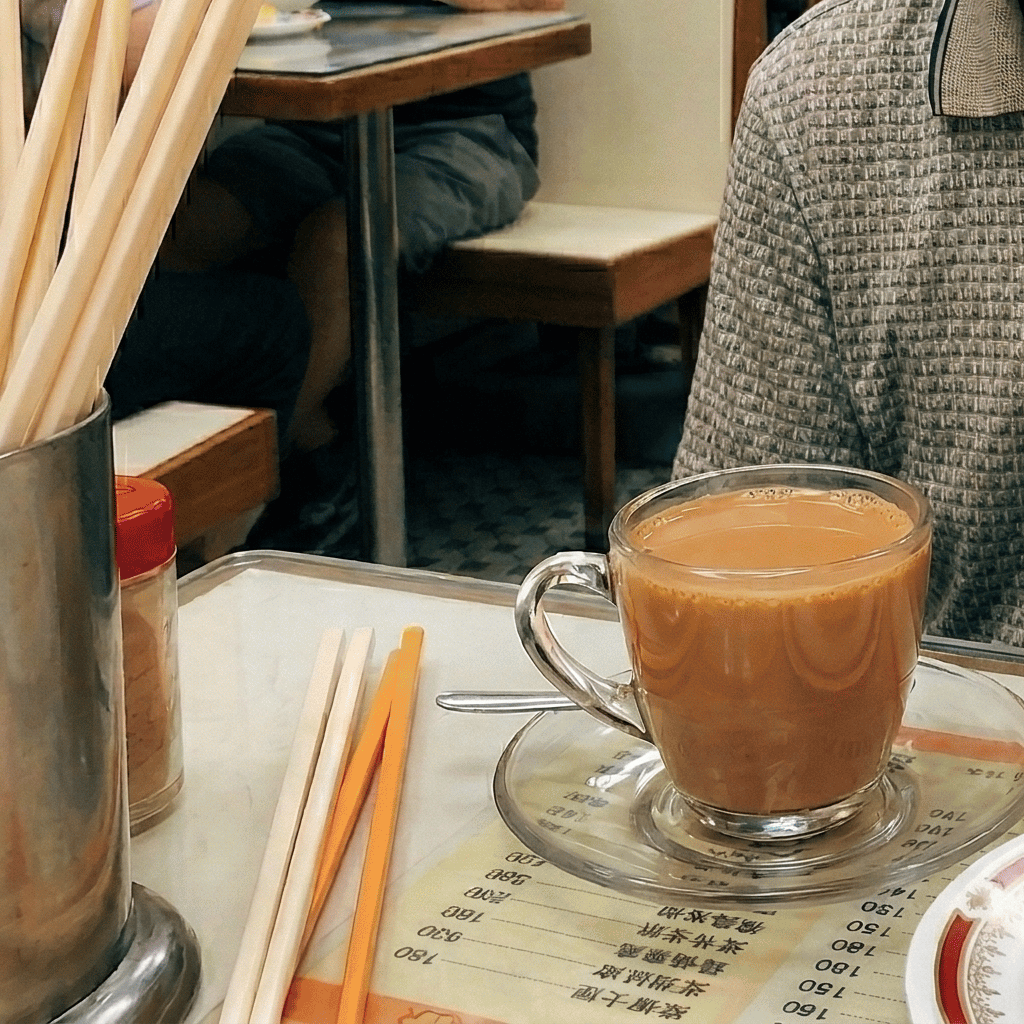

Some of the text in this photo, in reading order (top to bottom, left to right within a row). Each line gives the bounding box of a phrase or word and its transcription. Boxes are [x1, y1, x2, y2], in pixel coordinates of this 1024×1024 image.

[846, 920, 891, 937] 150
[798, 979, 845, 999] 150
[782, 1001, 828, 1020] 160
